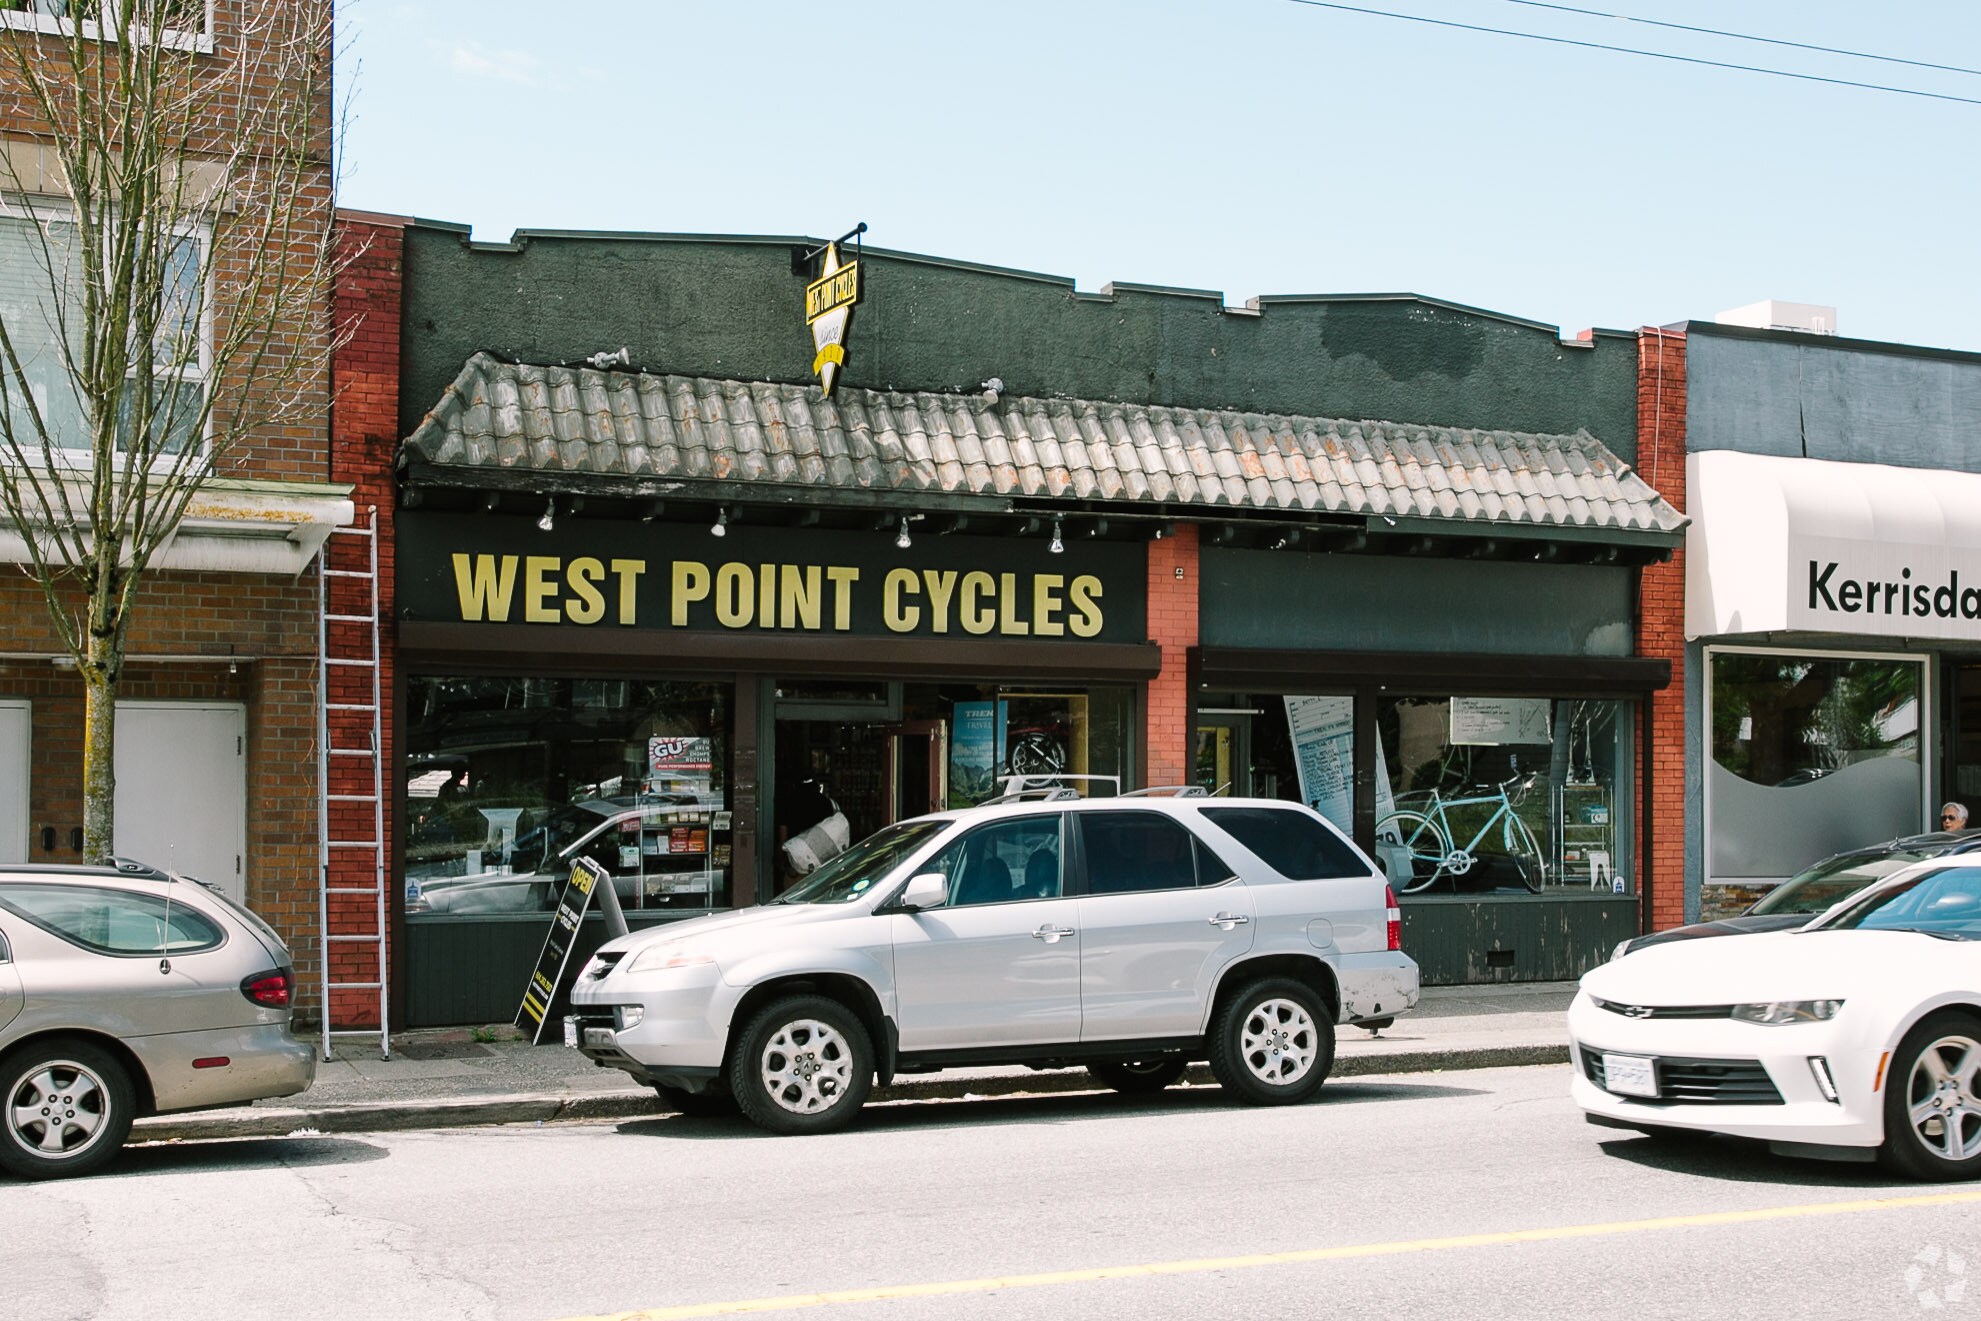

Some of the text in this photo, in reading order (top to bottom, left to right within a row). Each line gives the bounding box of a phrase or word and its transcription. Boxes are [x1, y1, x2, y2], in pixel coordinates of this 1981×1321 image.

[821, 278, 836, 311] POINT
[836, 268, 855, 304] CYCLES
[452, 553, 1104, 637] WEST POINT CYCLES
[1808, 560, 1981, 620] Kerrisda
[965, 710, 993, 718] TREK
[654, 740, 683, 758] GU
[571, 866, 594, 896] OPEN
